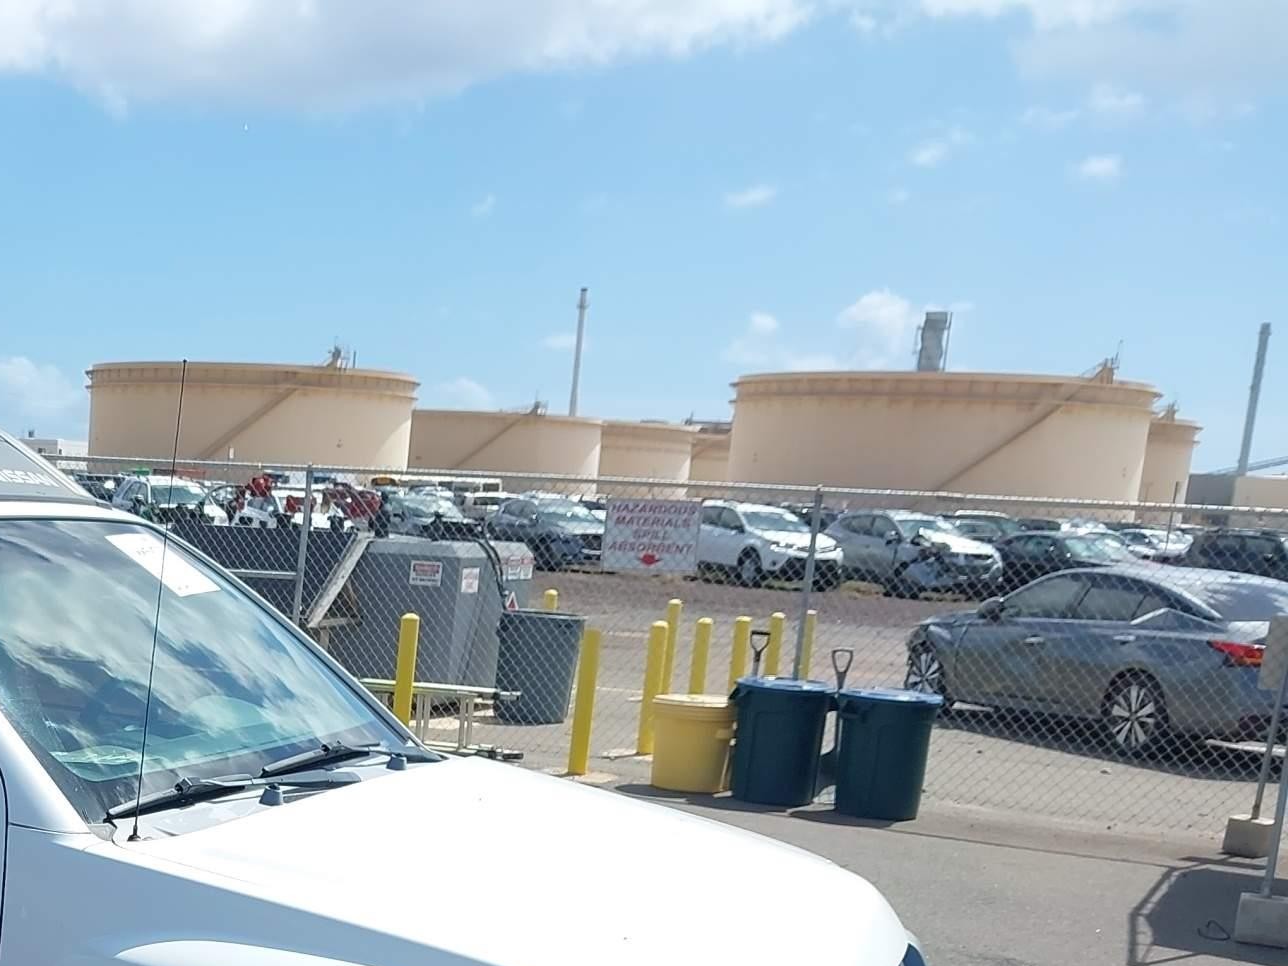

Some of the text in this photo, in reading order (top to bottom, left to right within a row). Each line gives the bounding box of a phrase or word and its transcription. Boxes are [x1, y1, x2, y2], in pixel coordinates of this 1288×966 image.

[610, 503, 698, 515] HAZARDOUS
[614, 515, 692, 528] MATERIALS
[632, 528, 670, 540] SPILL
[607, 540, 694, 555] ABSORBENT
